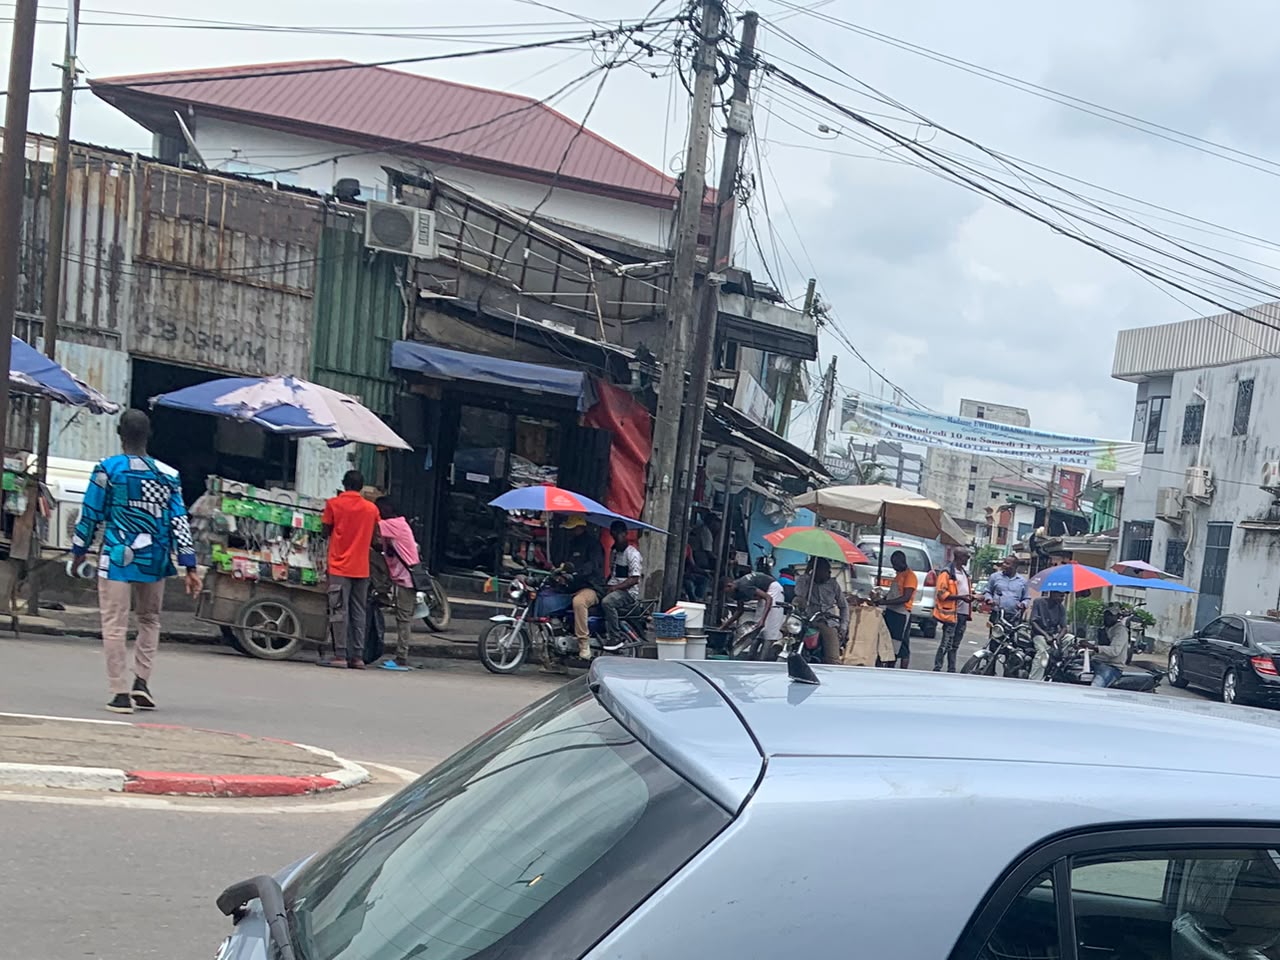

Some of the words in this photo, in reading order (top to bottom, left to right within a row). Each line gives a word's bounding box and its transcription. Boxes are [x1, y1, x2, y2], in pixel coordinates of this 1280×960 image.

[891, 422, 903, 430] Du
[907, 425, 946, 437] Vendredi
[951, 431, 962, 439] 10
[980, 436, 1015, 447] Samedi
[897, 432, 943, 446] DOUALA
